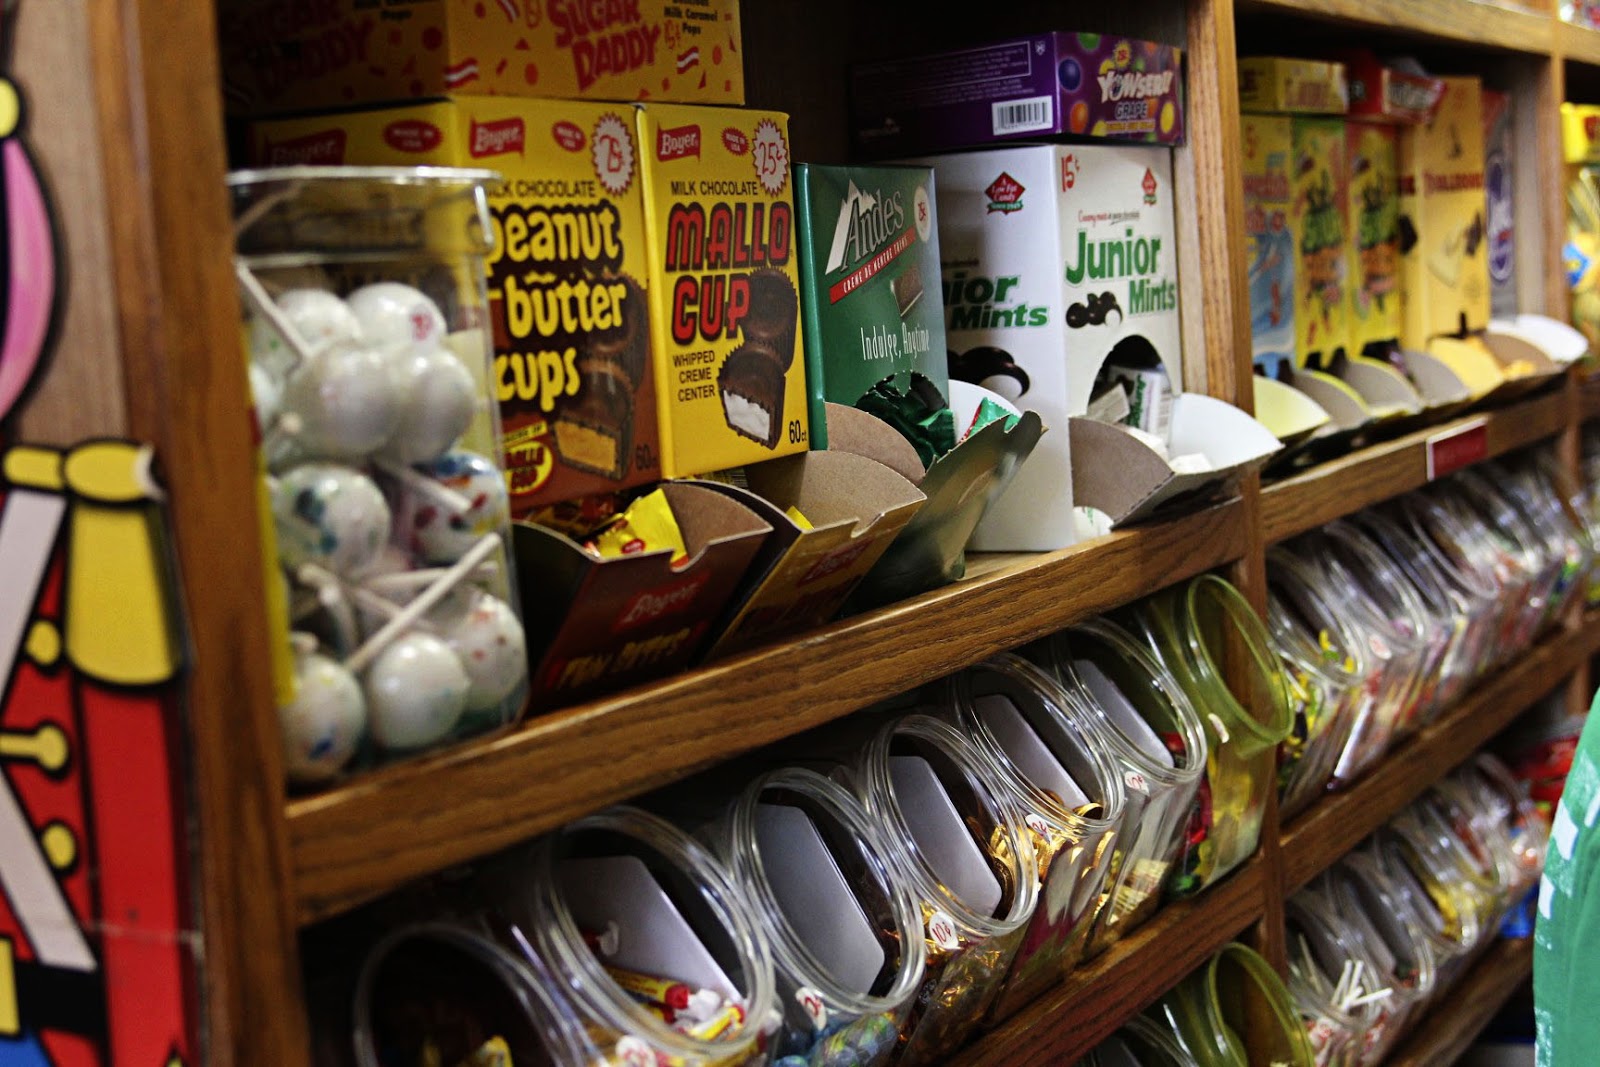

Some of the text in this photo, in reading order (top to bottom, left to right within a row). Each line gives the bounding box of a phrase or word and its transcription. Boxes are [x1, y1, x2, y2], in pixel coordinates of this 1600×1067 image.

[547, 0, 641, 48] SUGAR
[572, 23, 661, 92] DADDY
[660, 132, 699, 156] Boyer
[516, 179, 596, 199] CHOCOLATE
[671, 180, 759, 196] MILK CHOCOLATE
[665, 200, 792, 272] MALLO
[840, 189, 904, 273] Andes
[1065, 228, 1161, 286] Junior
[842, 271, 863, 294] CREME
[1128, 279, 1176, 315] Mints
[504, 275, 627, 339] butter
[670, 273, 752, 346] CUP
[951, 303, 1048, 330] Mints
[901, 321, 930, 359] Anytime
[672, 350, 716, 368] WHIPPED
[679, 367, 712, 384] CREME
[492, 346, 581, 412] cups
[677, 384, 716, 402] CENTER
